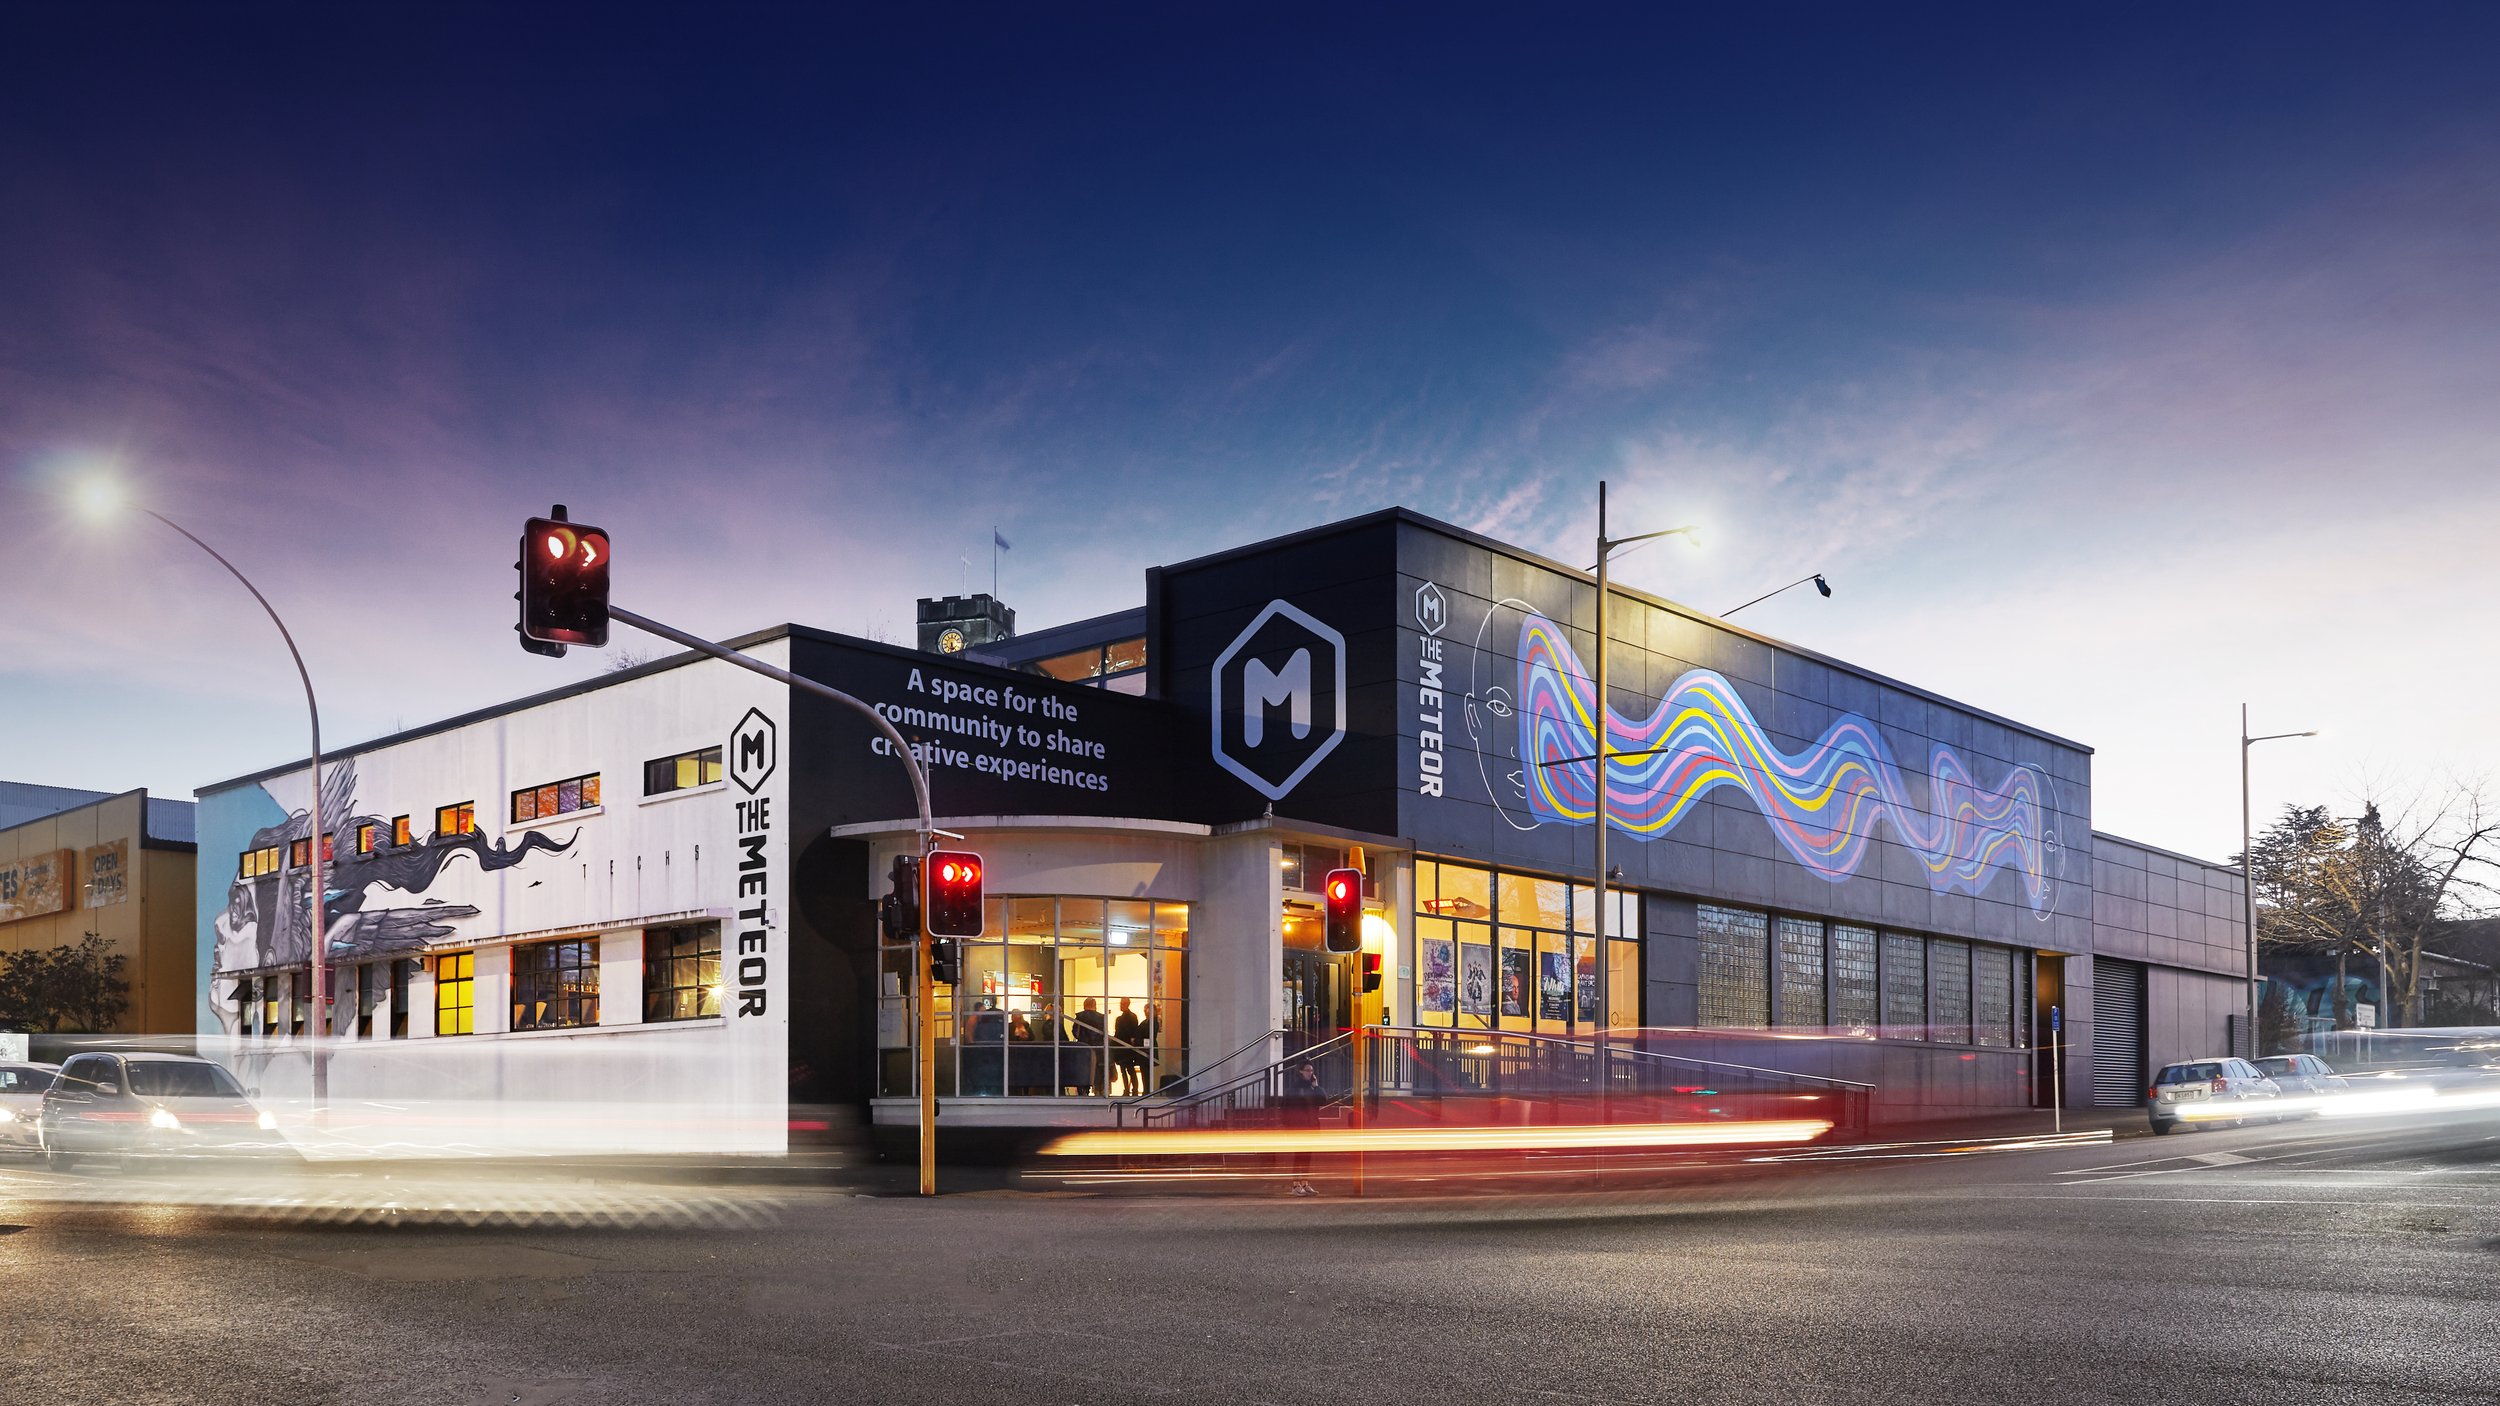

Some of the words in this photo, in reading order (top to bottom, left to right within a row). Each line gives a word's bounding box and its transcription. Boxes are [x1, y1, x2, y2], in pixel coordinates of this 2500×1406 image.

[1423, 594, 1439, 623] M
[1420, 635, 1443, 661] THE
[907, 668, 925, 693] A
[931, 677, 998, 704] space
[1003, 686, 1036, 714] for
[1042, 696, 1078, 722] the
[1244, 647, 1311, 748] M
[741, 729, 765, 773] M
[874, 702, 1012, 747] community
[1017, 724, 1041, 747] to
[1046, 729, 1106, 759] share
[1419, 659, 1443, 798] METEOR
[871, 737, 969, 769] crative
[974, 754, 1109, 792] experiences
[736, 797, 770, 834] THE
[94, 852, 118, 873] OPEN
[97, 874, 122, 895] DAYS
[738, 834, 767, 1018] METEOR
